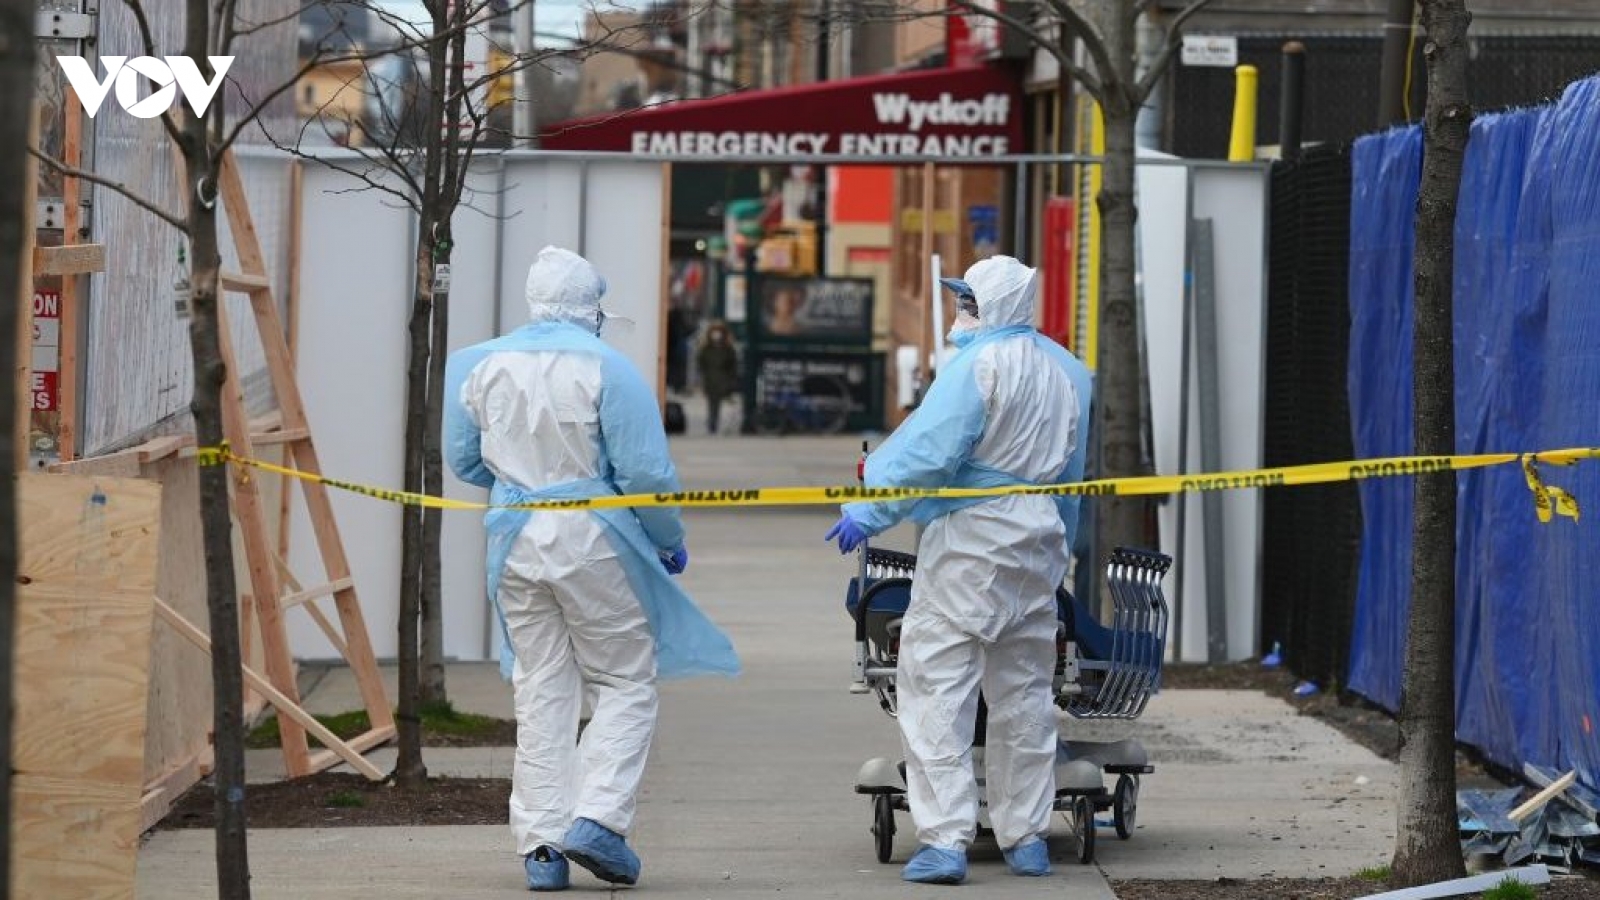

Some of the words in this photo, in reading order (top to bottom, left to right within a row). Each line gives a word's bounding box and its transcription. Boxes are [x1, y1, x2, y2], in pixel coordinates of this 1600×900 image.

[873, 92, 1010, 131] Wyckoff
[631, 131, 828, 156] EMERGENCY
[839, 134, 1009, 156] ENTRANCE
